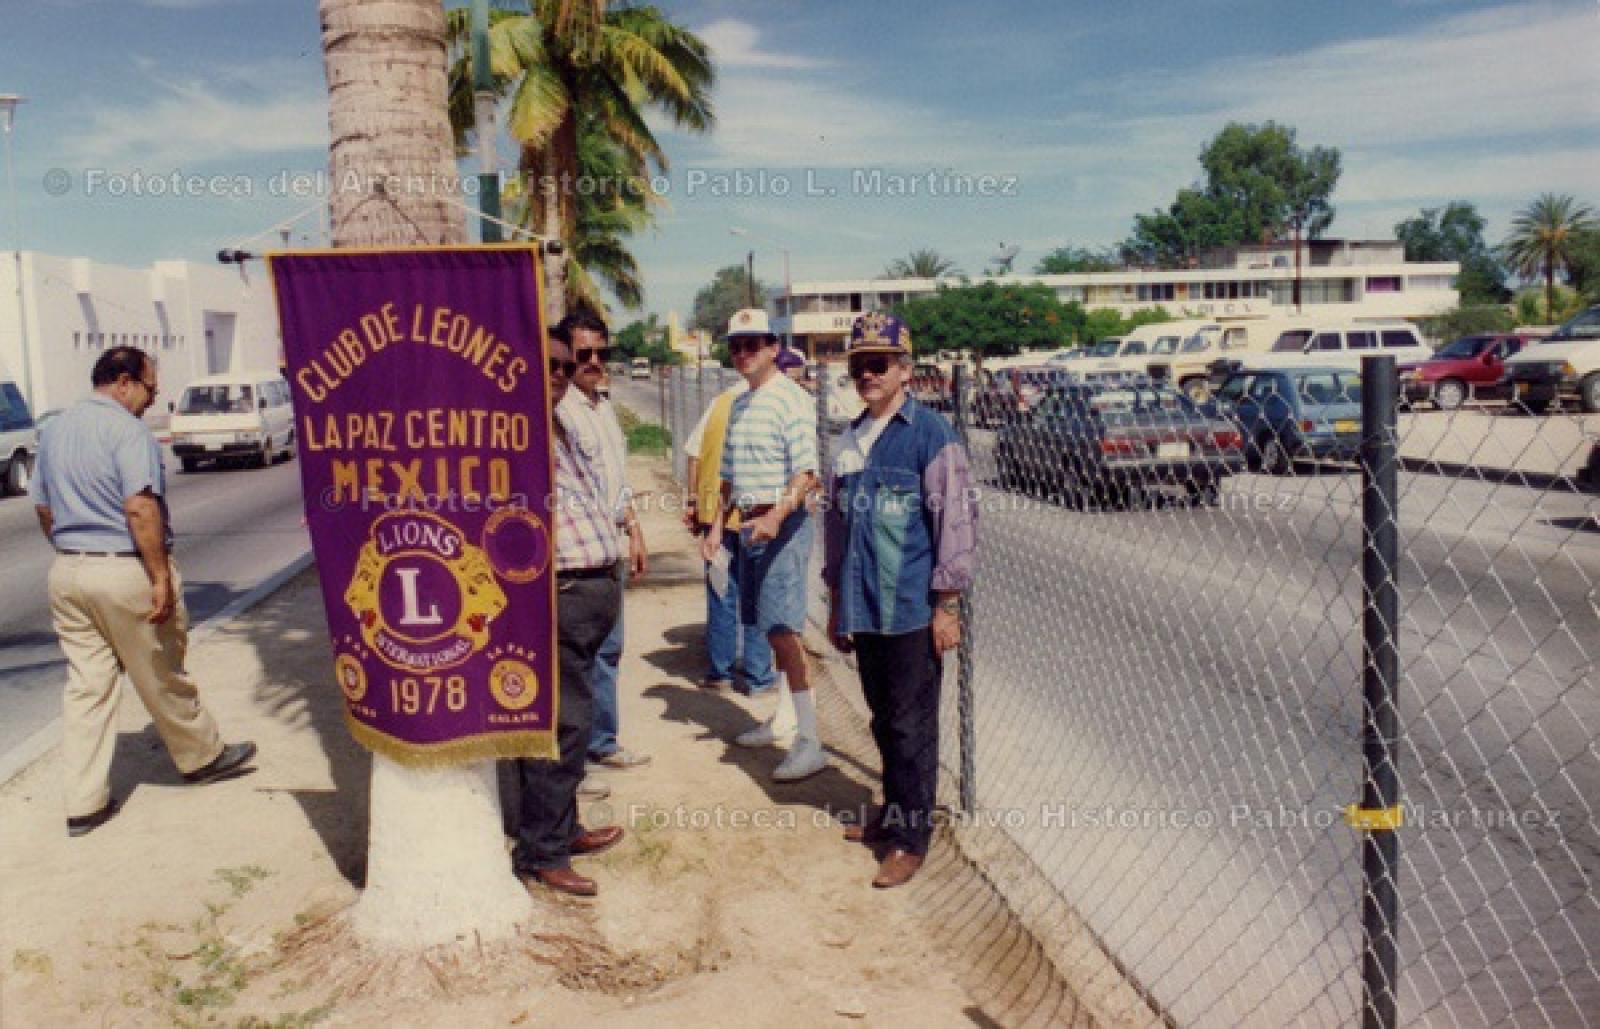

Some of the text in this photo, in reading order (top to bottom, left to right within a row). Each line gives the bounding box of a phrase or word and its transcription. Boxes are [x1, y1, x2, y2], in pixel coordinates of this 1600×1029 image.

[297, 302, 528, 403] CLUB DE LEONES
[304, 408, 529, 451] LA PAZ CENTRO
[332, 456, 510, 503] MEXICO
[379, 521, 460, 556] LIONS
[395, 567, 443, 625] L
[390, 675, 468, 716] 1978
